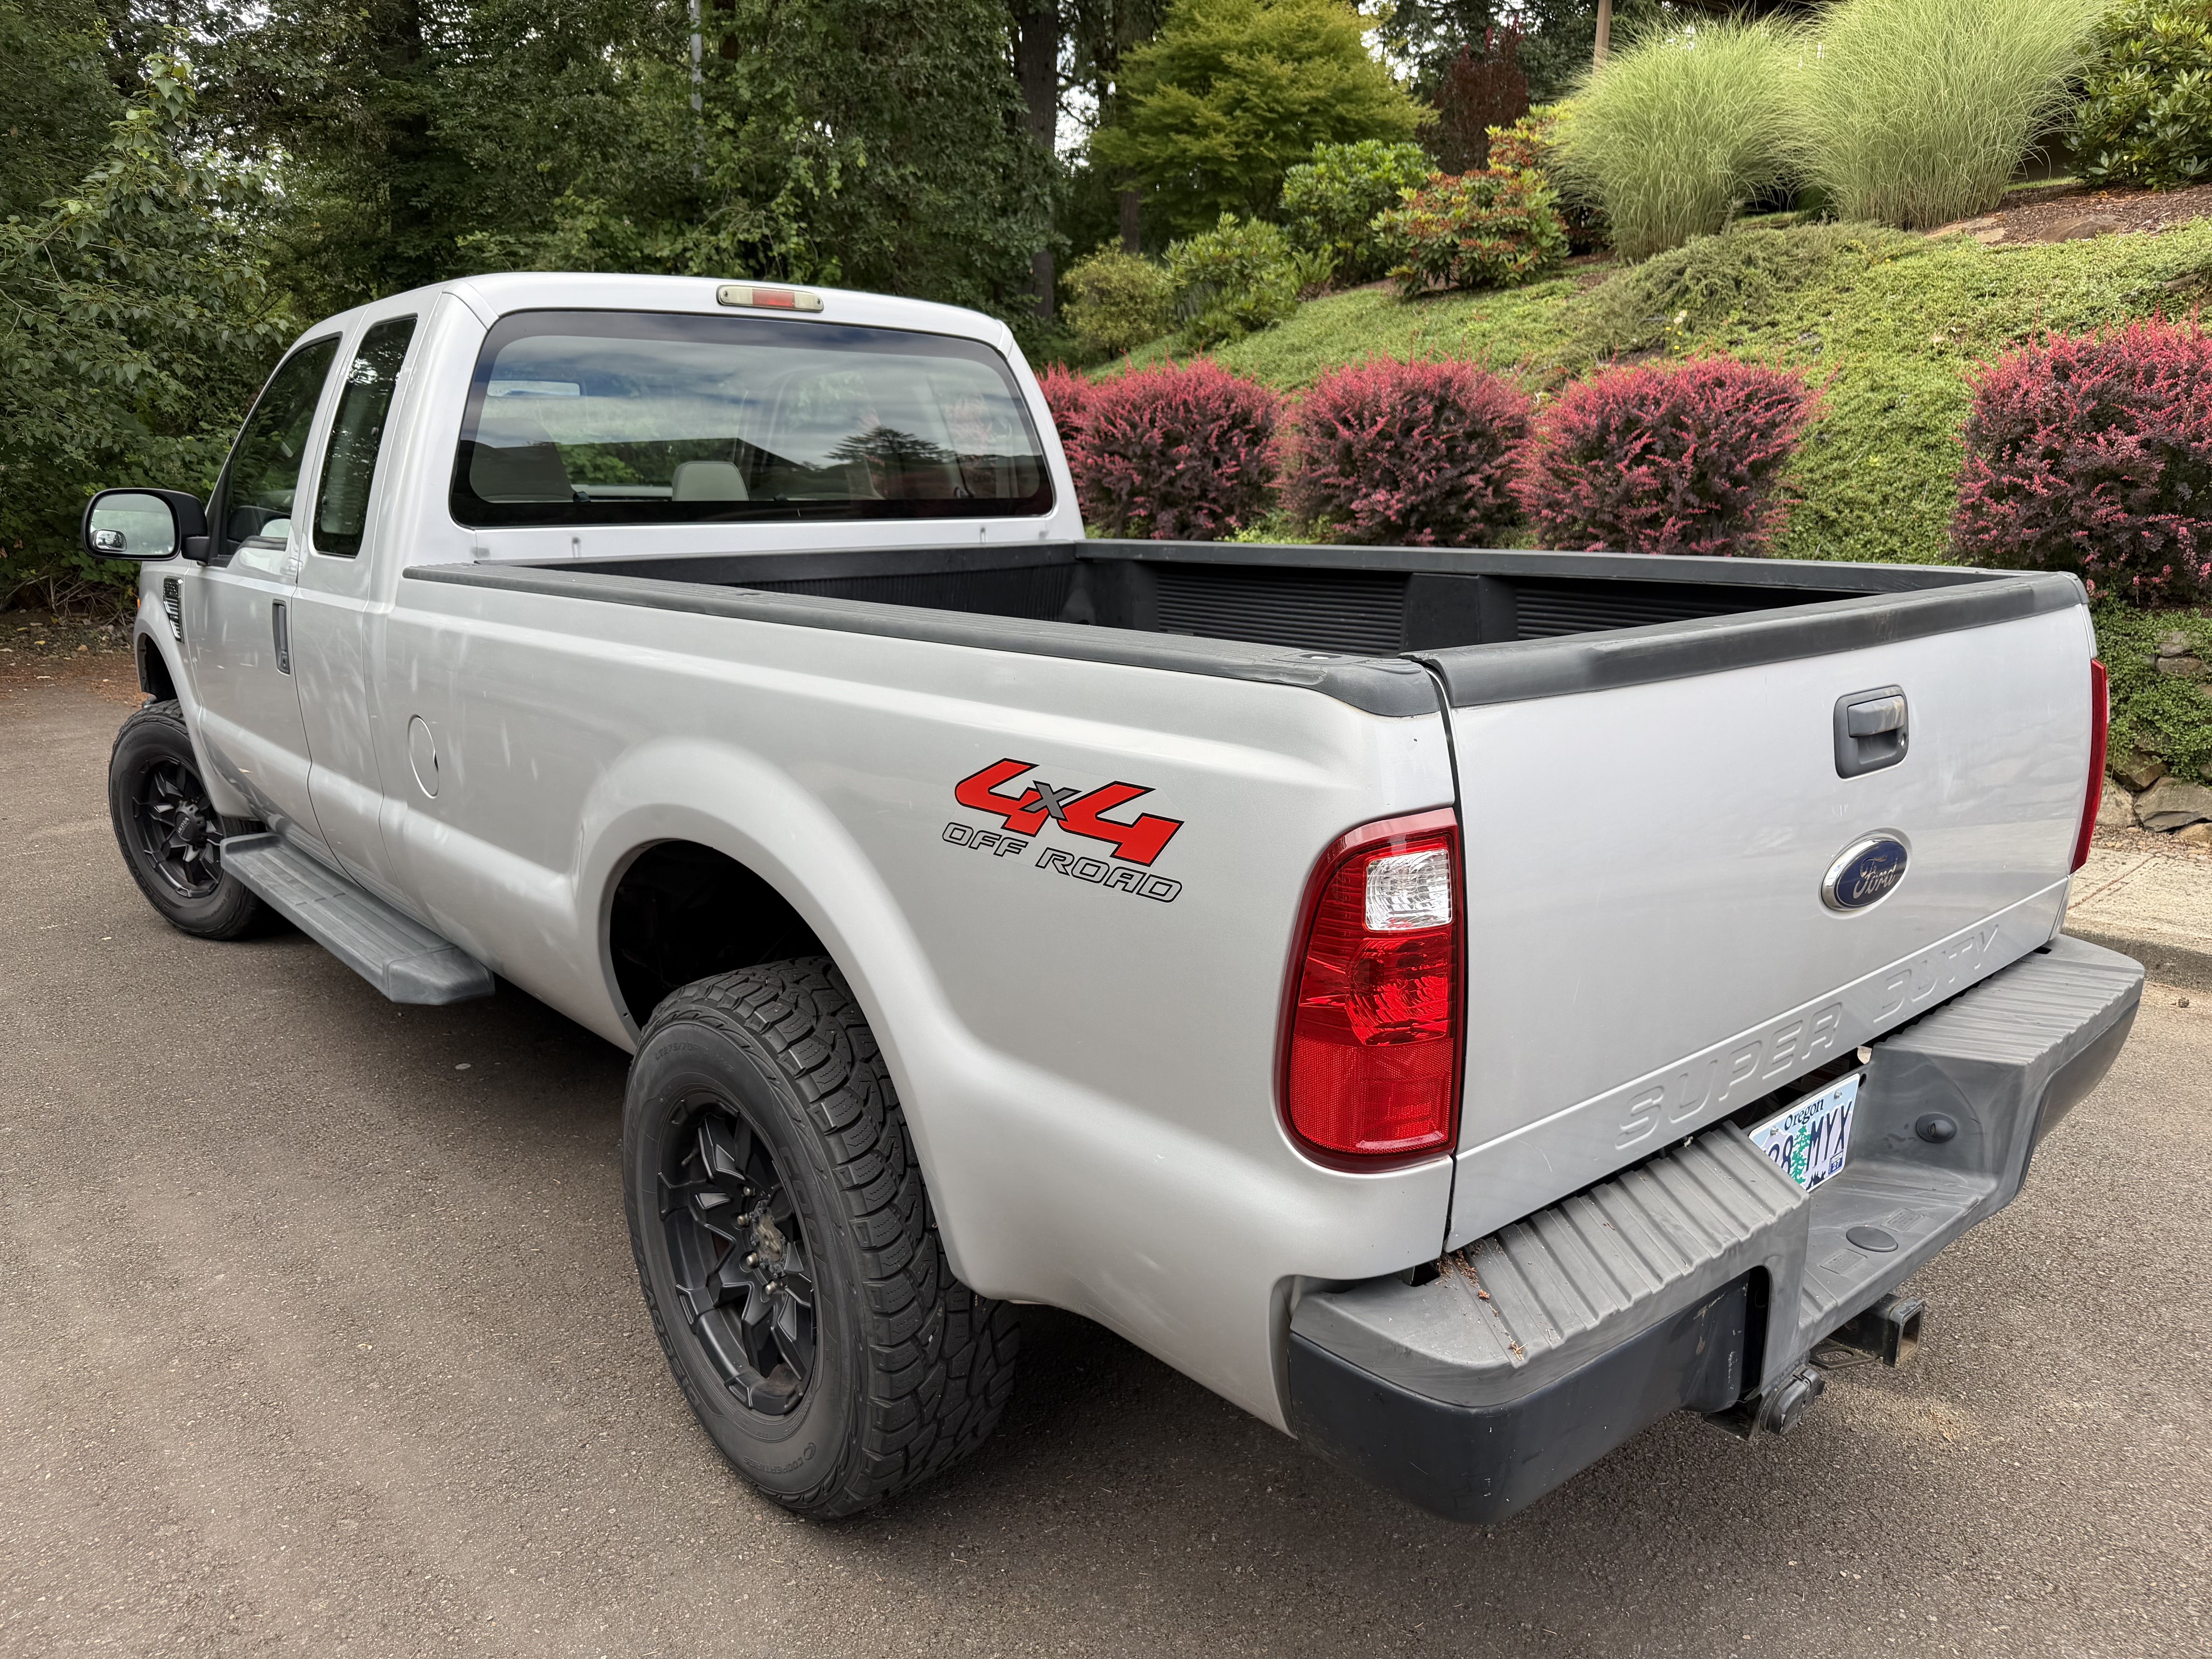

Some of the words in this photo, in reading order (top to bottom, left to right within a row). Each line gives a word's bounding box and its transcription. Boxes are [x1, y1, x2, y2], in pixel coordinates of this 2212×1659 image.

[942, 822, 1029, 857] OFF
[1035, 847, 1183, 903] ROAD
[1853, 853, 1898, 899] Ford
[1614, 1001, 1843, 1151] SUPER
[1873, 923, 1999, 1024] DUTY
[1784, 1099, 1824, 1131] Oregon
[1806, 1100, 1853, 1172] MYX
[1832, 1159, 1841, 1171] 27
